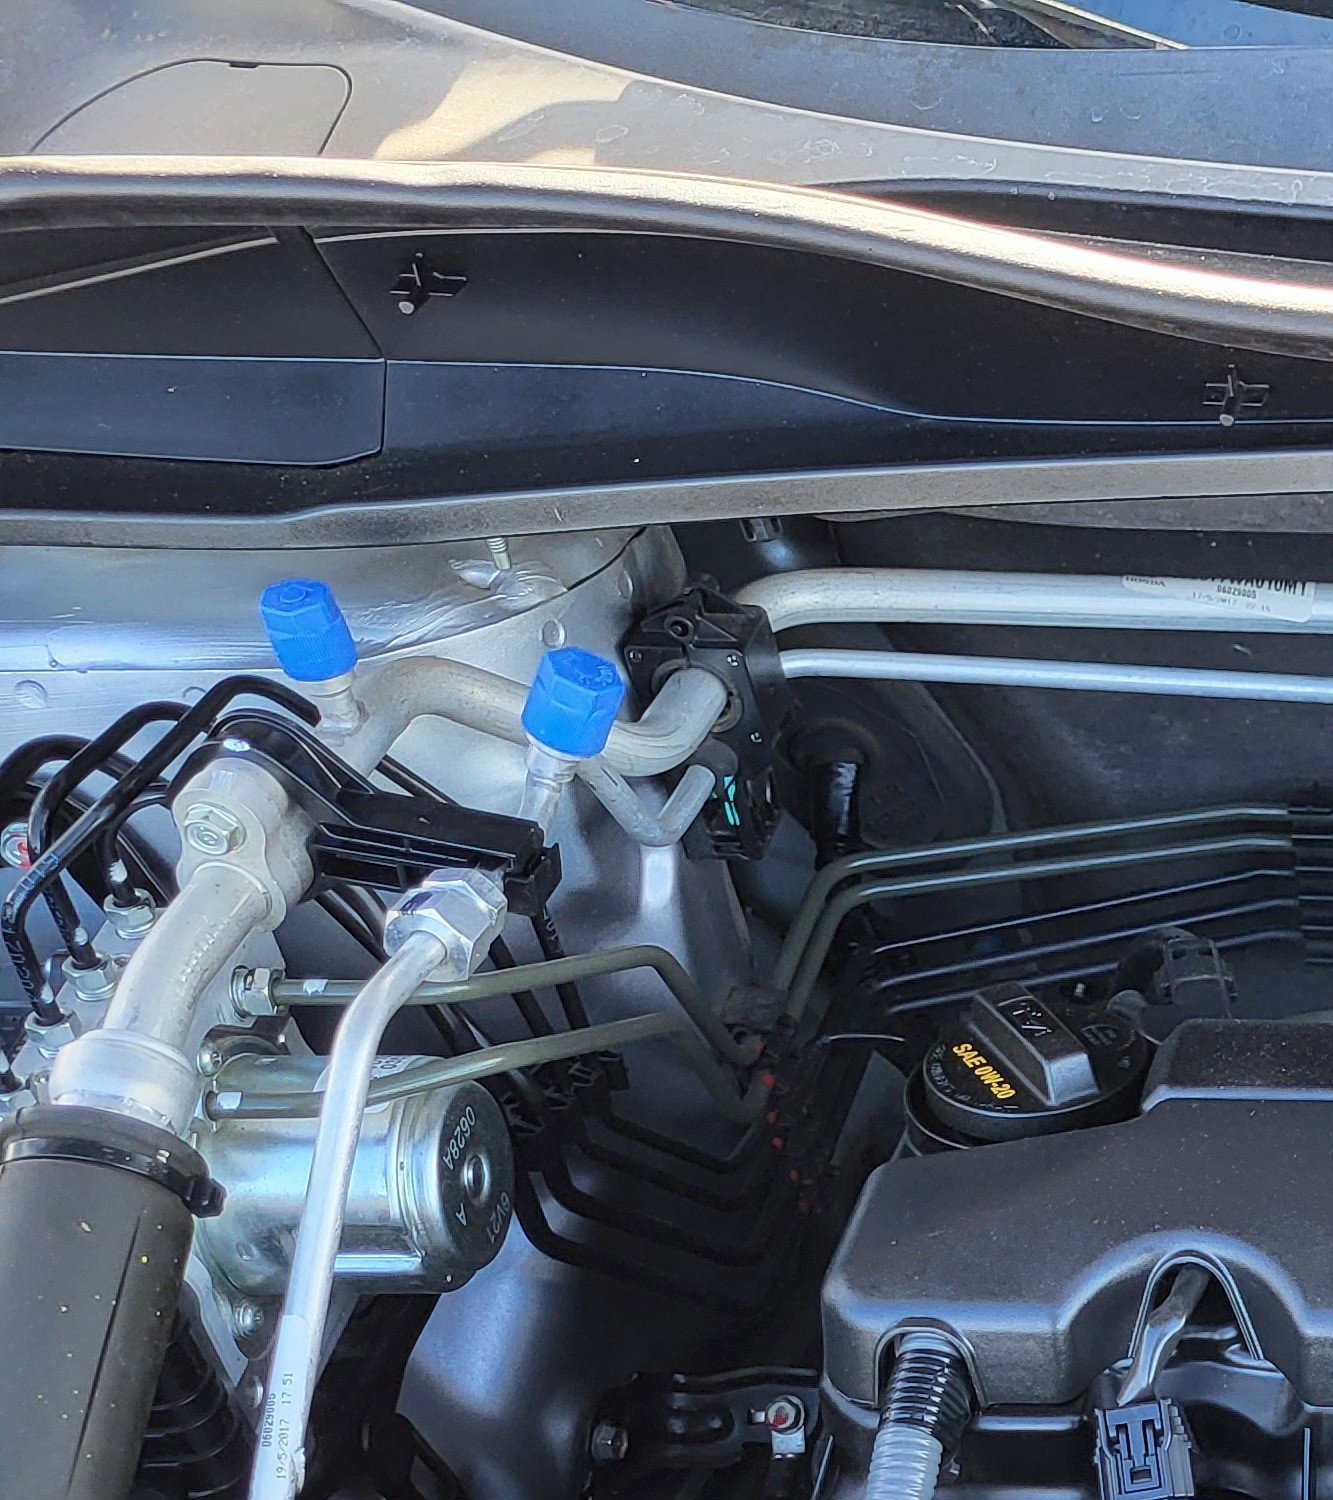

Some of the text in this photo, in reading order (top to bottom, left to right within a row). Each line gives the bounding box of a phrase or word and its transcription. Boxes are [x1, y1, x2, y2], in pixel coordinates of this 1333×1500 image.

[952, 1043, 1017, 1100] SAE 0W-20
[442, 1104, 477, 1171] 0628A
